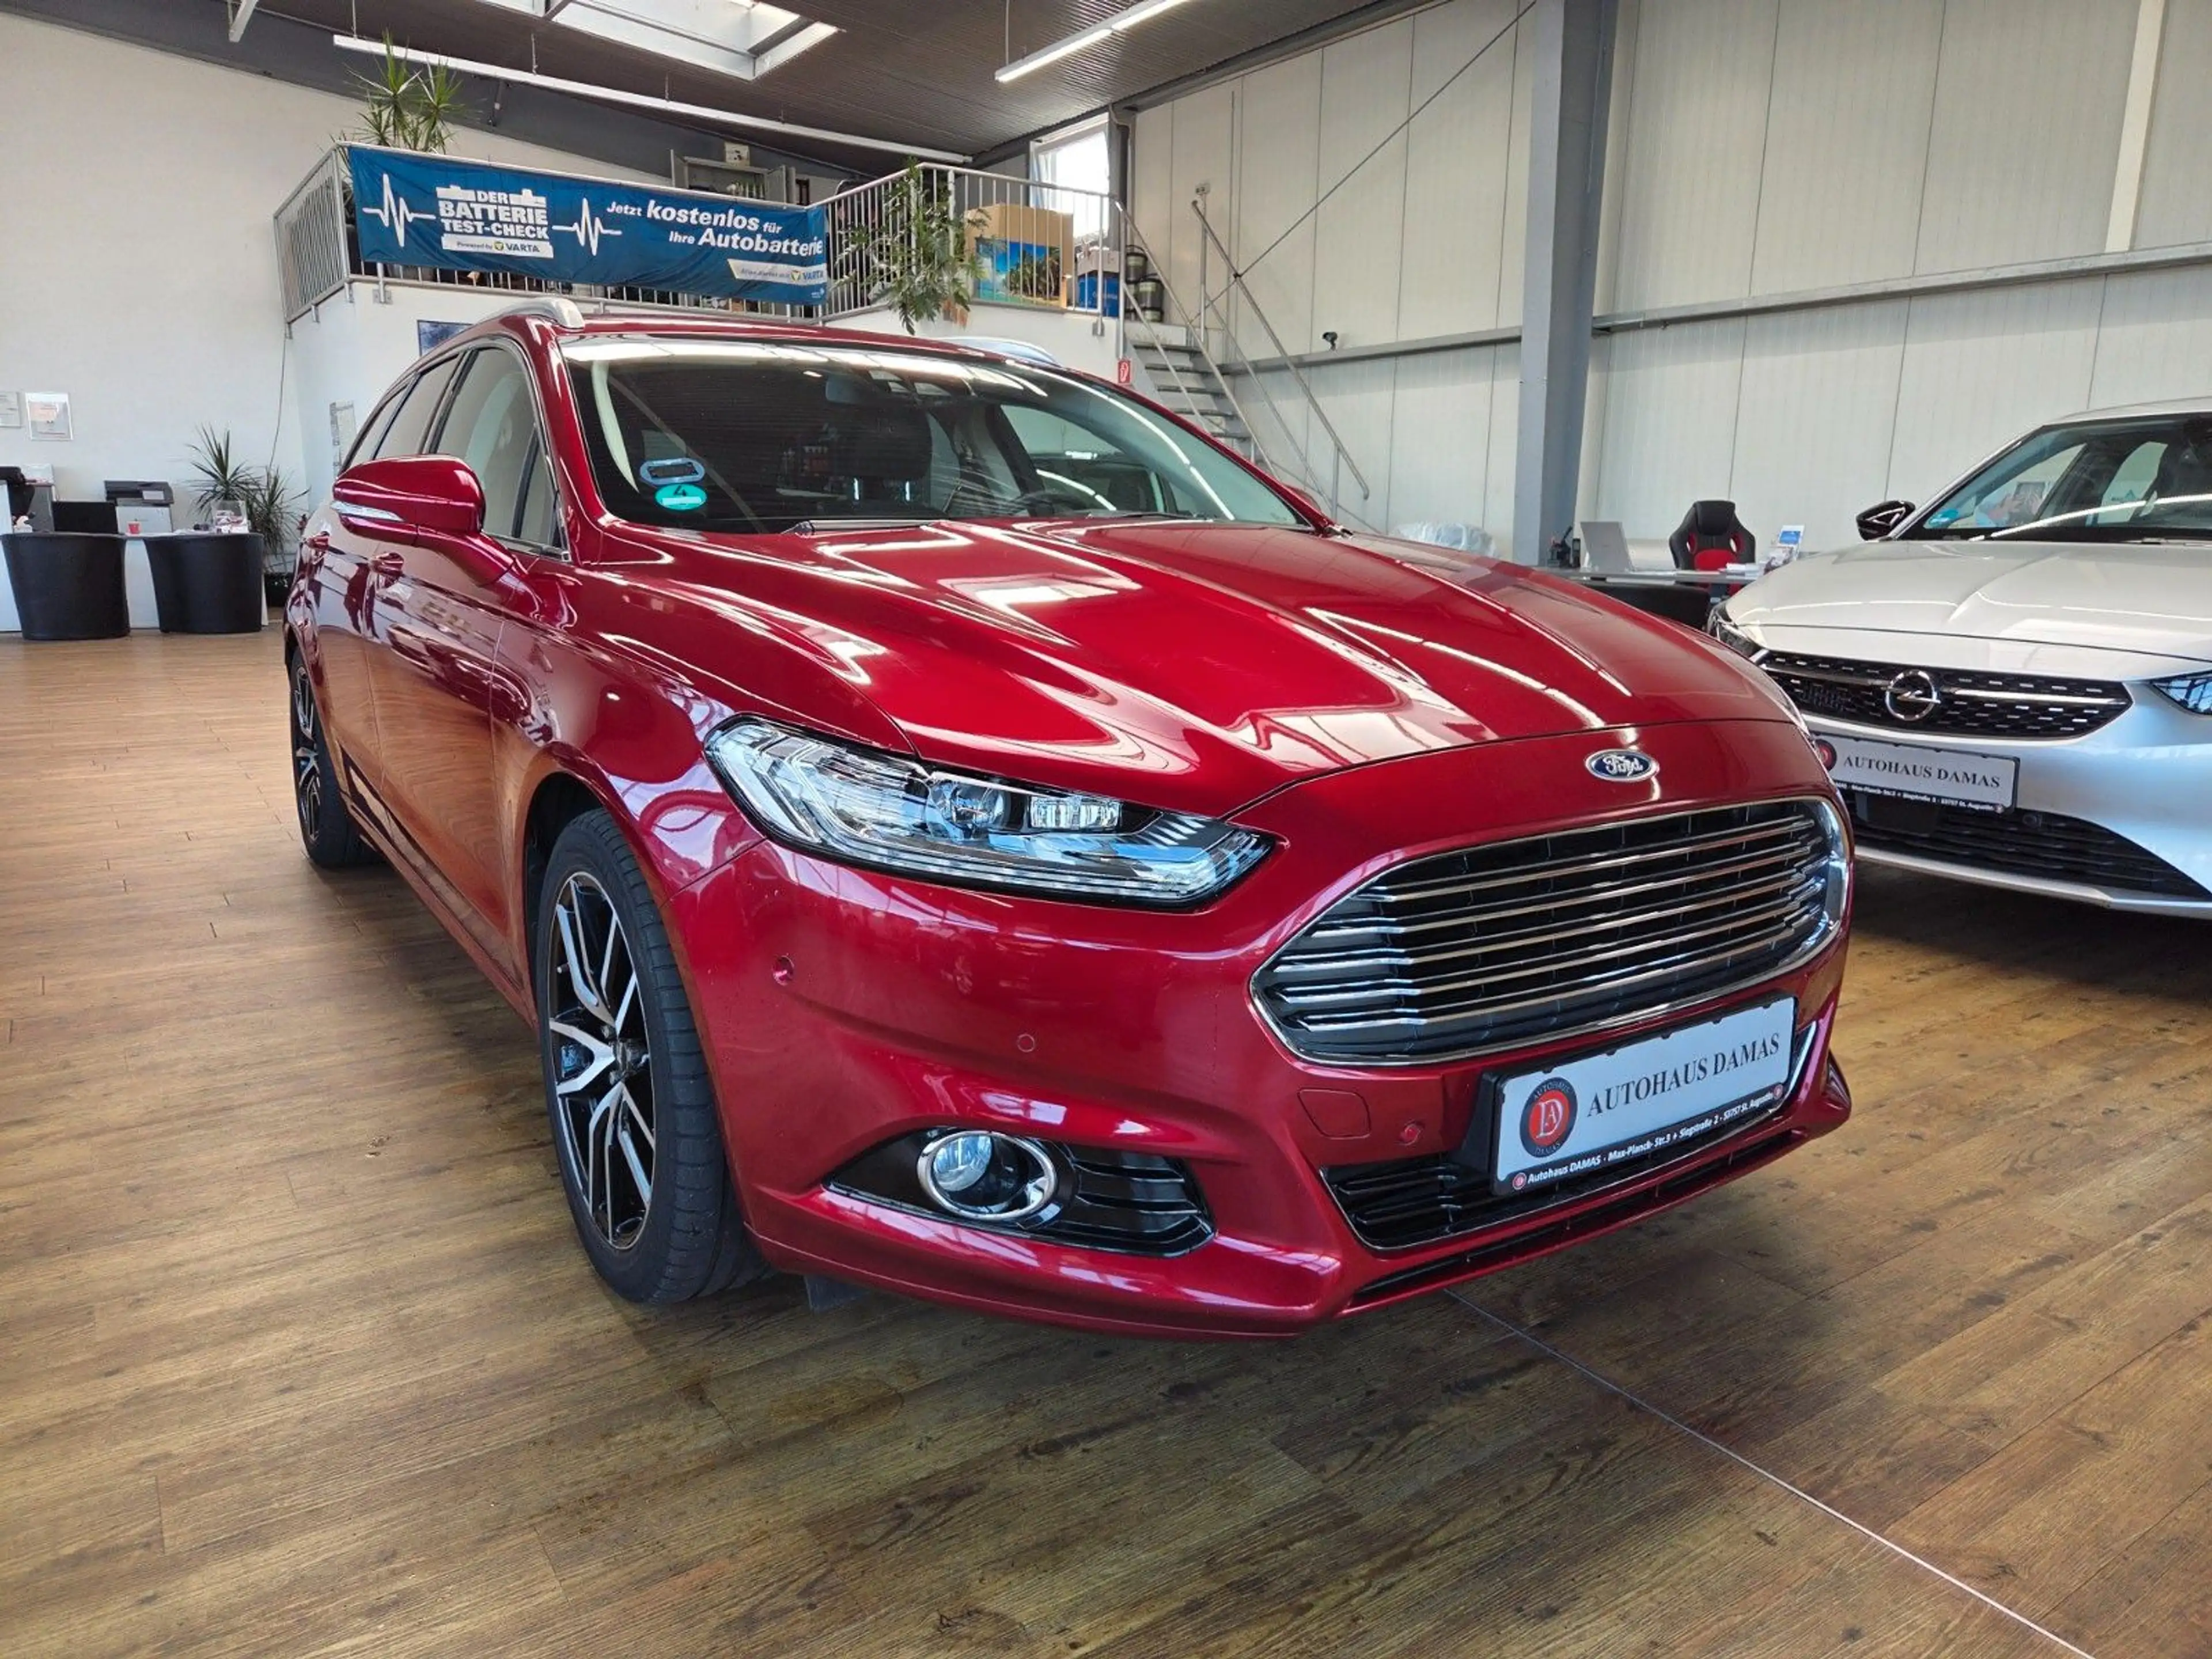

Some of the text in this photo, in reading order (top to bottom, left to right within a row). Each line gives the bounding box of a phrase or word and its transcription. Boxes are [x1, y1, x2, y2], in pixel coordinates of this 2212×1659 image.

[476, 191, 508, 204] DER
[438, 200, 548, 225] BATTERIE
[606, 199, 783, 234] Jetzt kostenlos für
[441, 218, 550, 239] TEST-CHECK
[506, 244, 540, 253] VARTA
[669, 228, 824, 257] Ihre Autobatterie
[802, 270, 824, 280] VARTA
[673, 485, 687, 497] 4
[1603, 753, 1643, 777] Ford
[1843, 755, 2001, 789] AUTOHAUS DAMAS
[1587, 1032, 1780, 1117] AUTOHAUS DAMAS
[1527, 1164, 1568, 1184] Autohaus
[1569, 1154, 1601, 1173] DAMAS
